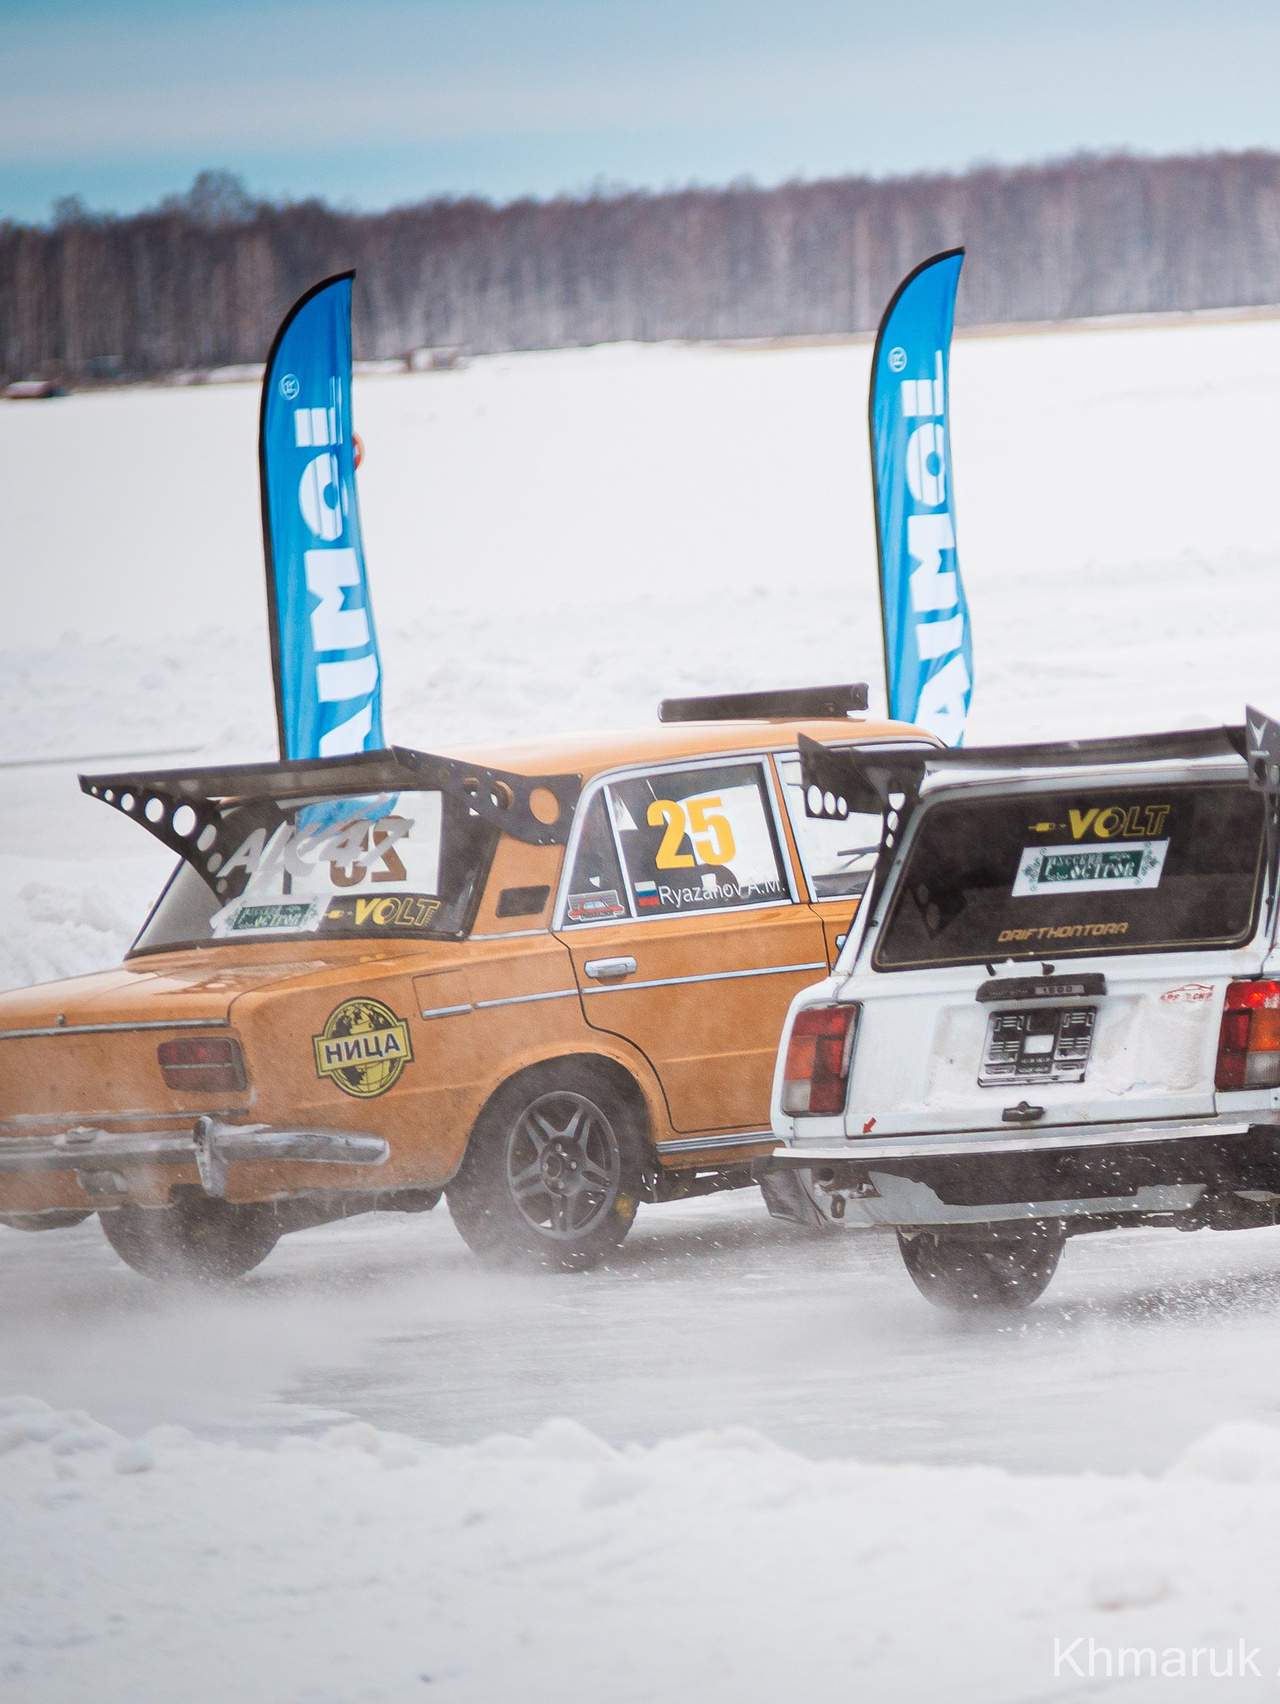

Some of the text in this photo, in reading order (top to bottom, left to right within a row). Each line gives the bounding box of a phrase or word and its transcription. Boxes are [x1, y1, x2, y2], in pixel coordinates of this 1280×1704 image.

[901, 349, 968, 746] AIMOL
[646, 796, 736, 869] 25
[1069, 805, 1170, 839] VOLT
[657, 882, 741, 908] Ryazanov
[355, 897, 441, 926] VOLT
[324, 1033, 401, 1064] НИЦА
